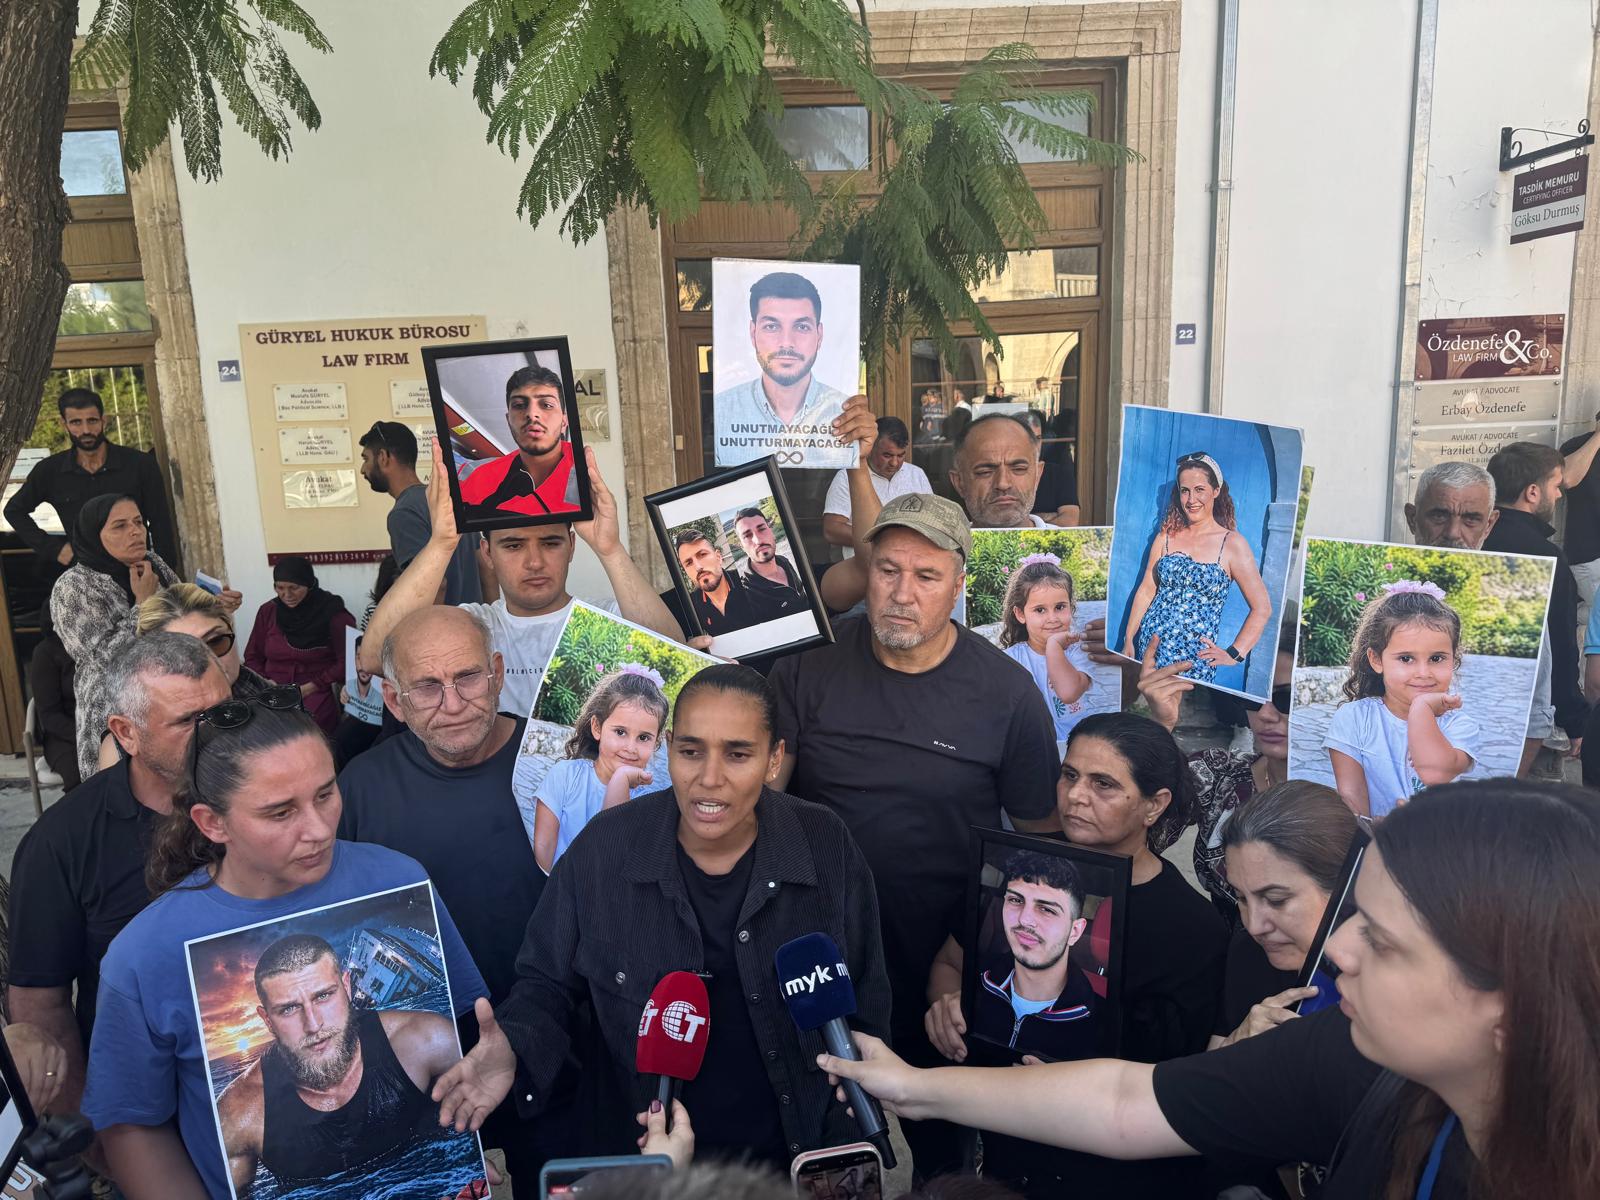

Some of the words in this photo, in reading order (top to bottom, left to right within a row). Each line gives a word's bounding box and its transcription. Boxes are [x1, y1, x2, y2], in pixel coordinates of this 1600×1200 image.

[1518, 179, 1543, 196] TASDİK
[1544, 171, 1580, 189] MEMURU
[1514, 212, 1541, 228] Göksu
[1542, 204, 1580, 221] Durmuş
[255, 329, 326, 345] GÜRYEL
[330, 327, 395, 342] HUKUK
[398, 324, 471, 340] BÜROSU
[1178, 329, 1194, 339] 22
[1427, 332, 1504, 352] Özdenefe
[322, 354, 359, 368] LAW
[364, 352, 410, 367] FIRM
[1453, 353, 1473, 362] LAW
[1475, 352, 1498, 362] FIRM
[221, 366, 237, 376] 24
[1484, 385, 1521, 395] ADVOCATE
[1441, 404, 1472, 417] Erbay
[1475, 401, 1527, 414] Özdenefe
[730, 422, 835, 435] UNUTMAYACAĞI
[1451, 433, 1478, 442] AVUKAT
[1484, 431, 1519, 440] ADVOCATE
[1440, 444, 1475, 456] Fazilet
[785, 965, 834, 996] myk
